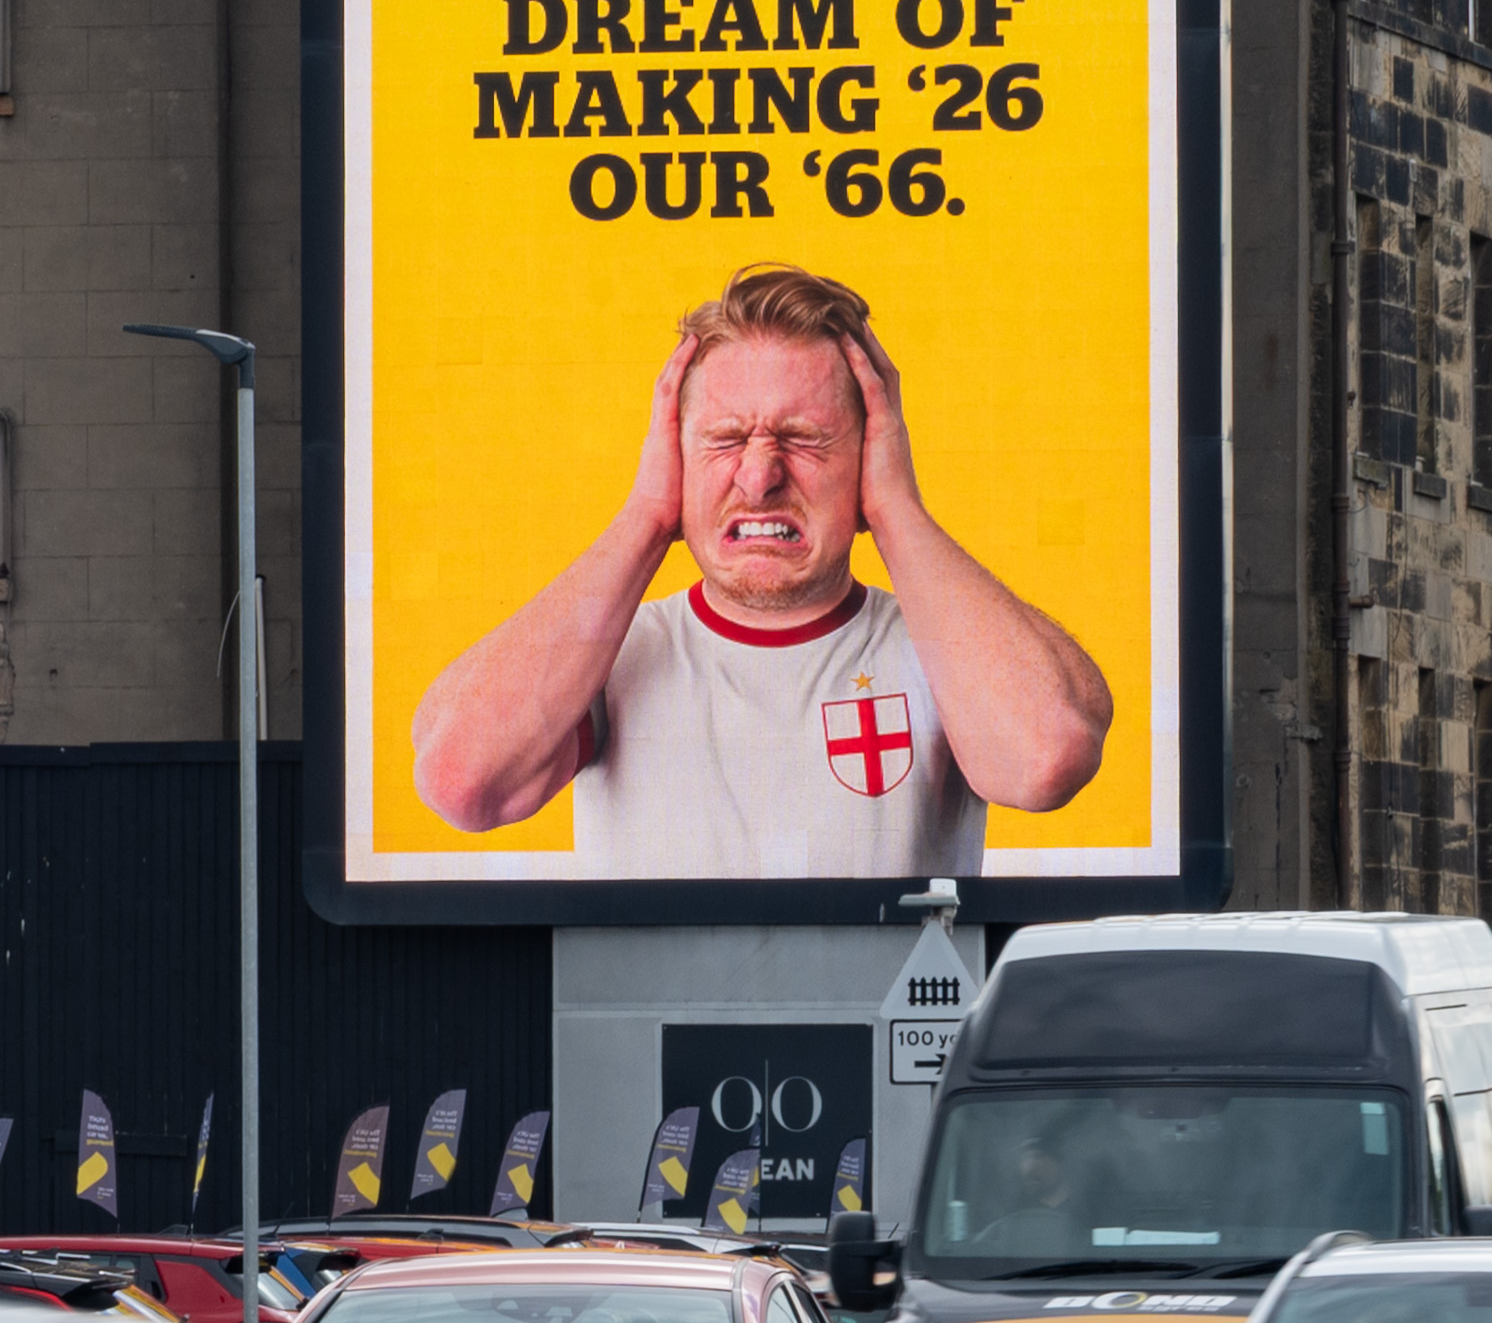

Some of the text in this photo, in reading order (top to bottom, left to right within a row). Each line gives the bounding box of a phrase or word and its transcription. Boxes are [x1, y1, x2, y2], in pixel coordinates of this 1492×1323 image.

[473, 66, 879, 138] MAKING
[570, 151, 774, 221] OUR
[898, 1031, 933, 1046] 100
